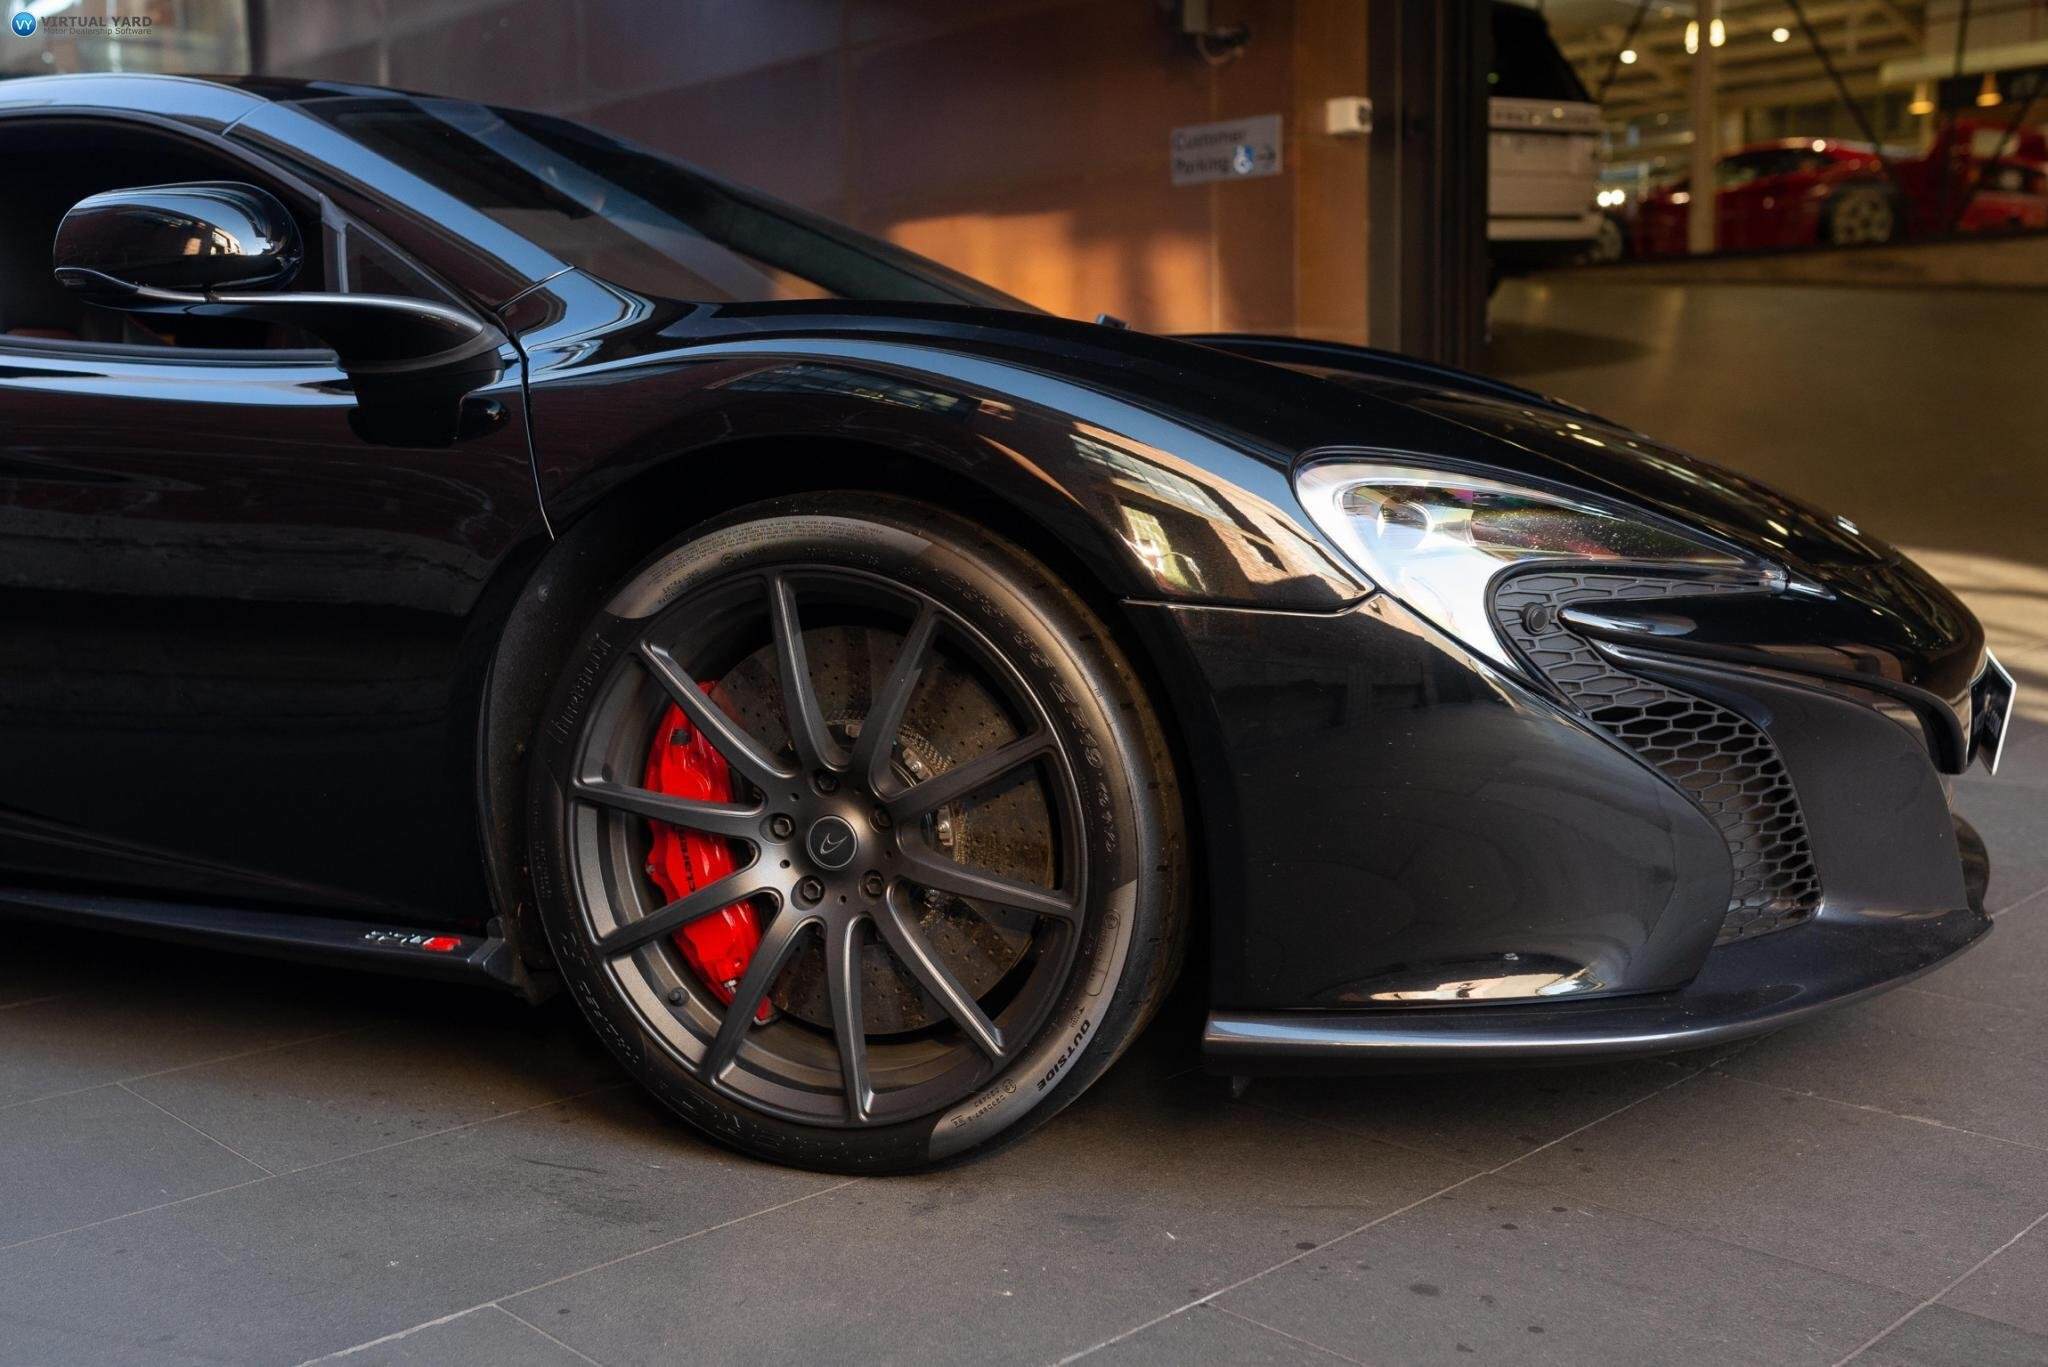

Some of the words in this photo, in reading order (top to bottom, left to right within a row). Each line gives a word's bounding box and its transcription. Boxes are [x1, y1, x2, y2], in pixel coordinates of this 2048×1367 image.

[1174, 130, 1247, 150] Customer
[1175, 157, 1230, 176] Parking
[1037, 1019, 1091, 1092] OUTSIDE
